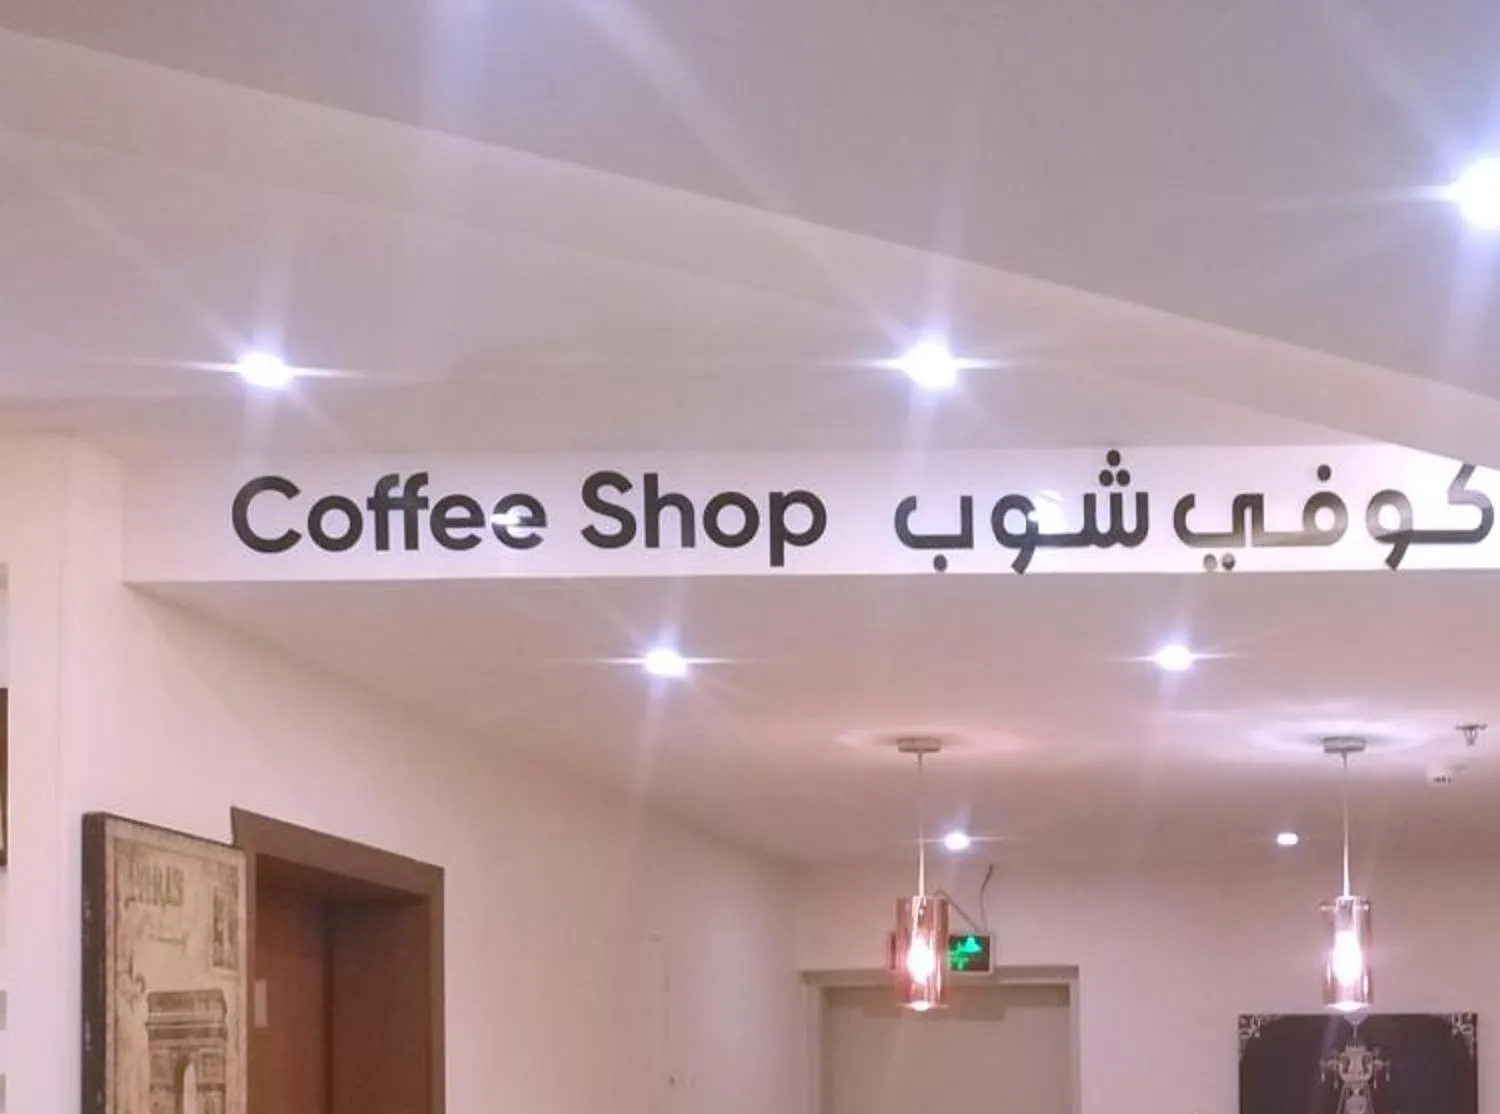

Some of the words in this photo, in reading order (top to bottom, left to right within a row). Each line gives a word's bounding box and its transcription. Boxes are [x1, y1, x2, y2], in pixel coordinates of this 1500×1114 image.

[232, 472, 547, 553] Coffee
[580, 470, 827, 567] Shop
[894, 449, 1149, 574] شوب
[1173, 463, 1494, 572] كوفي
